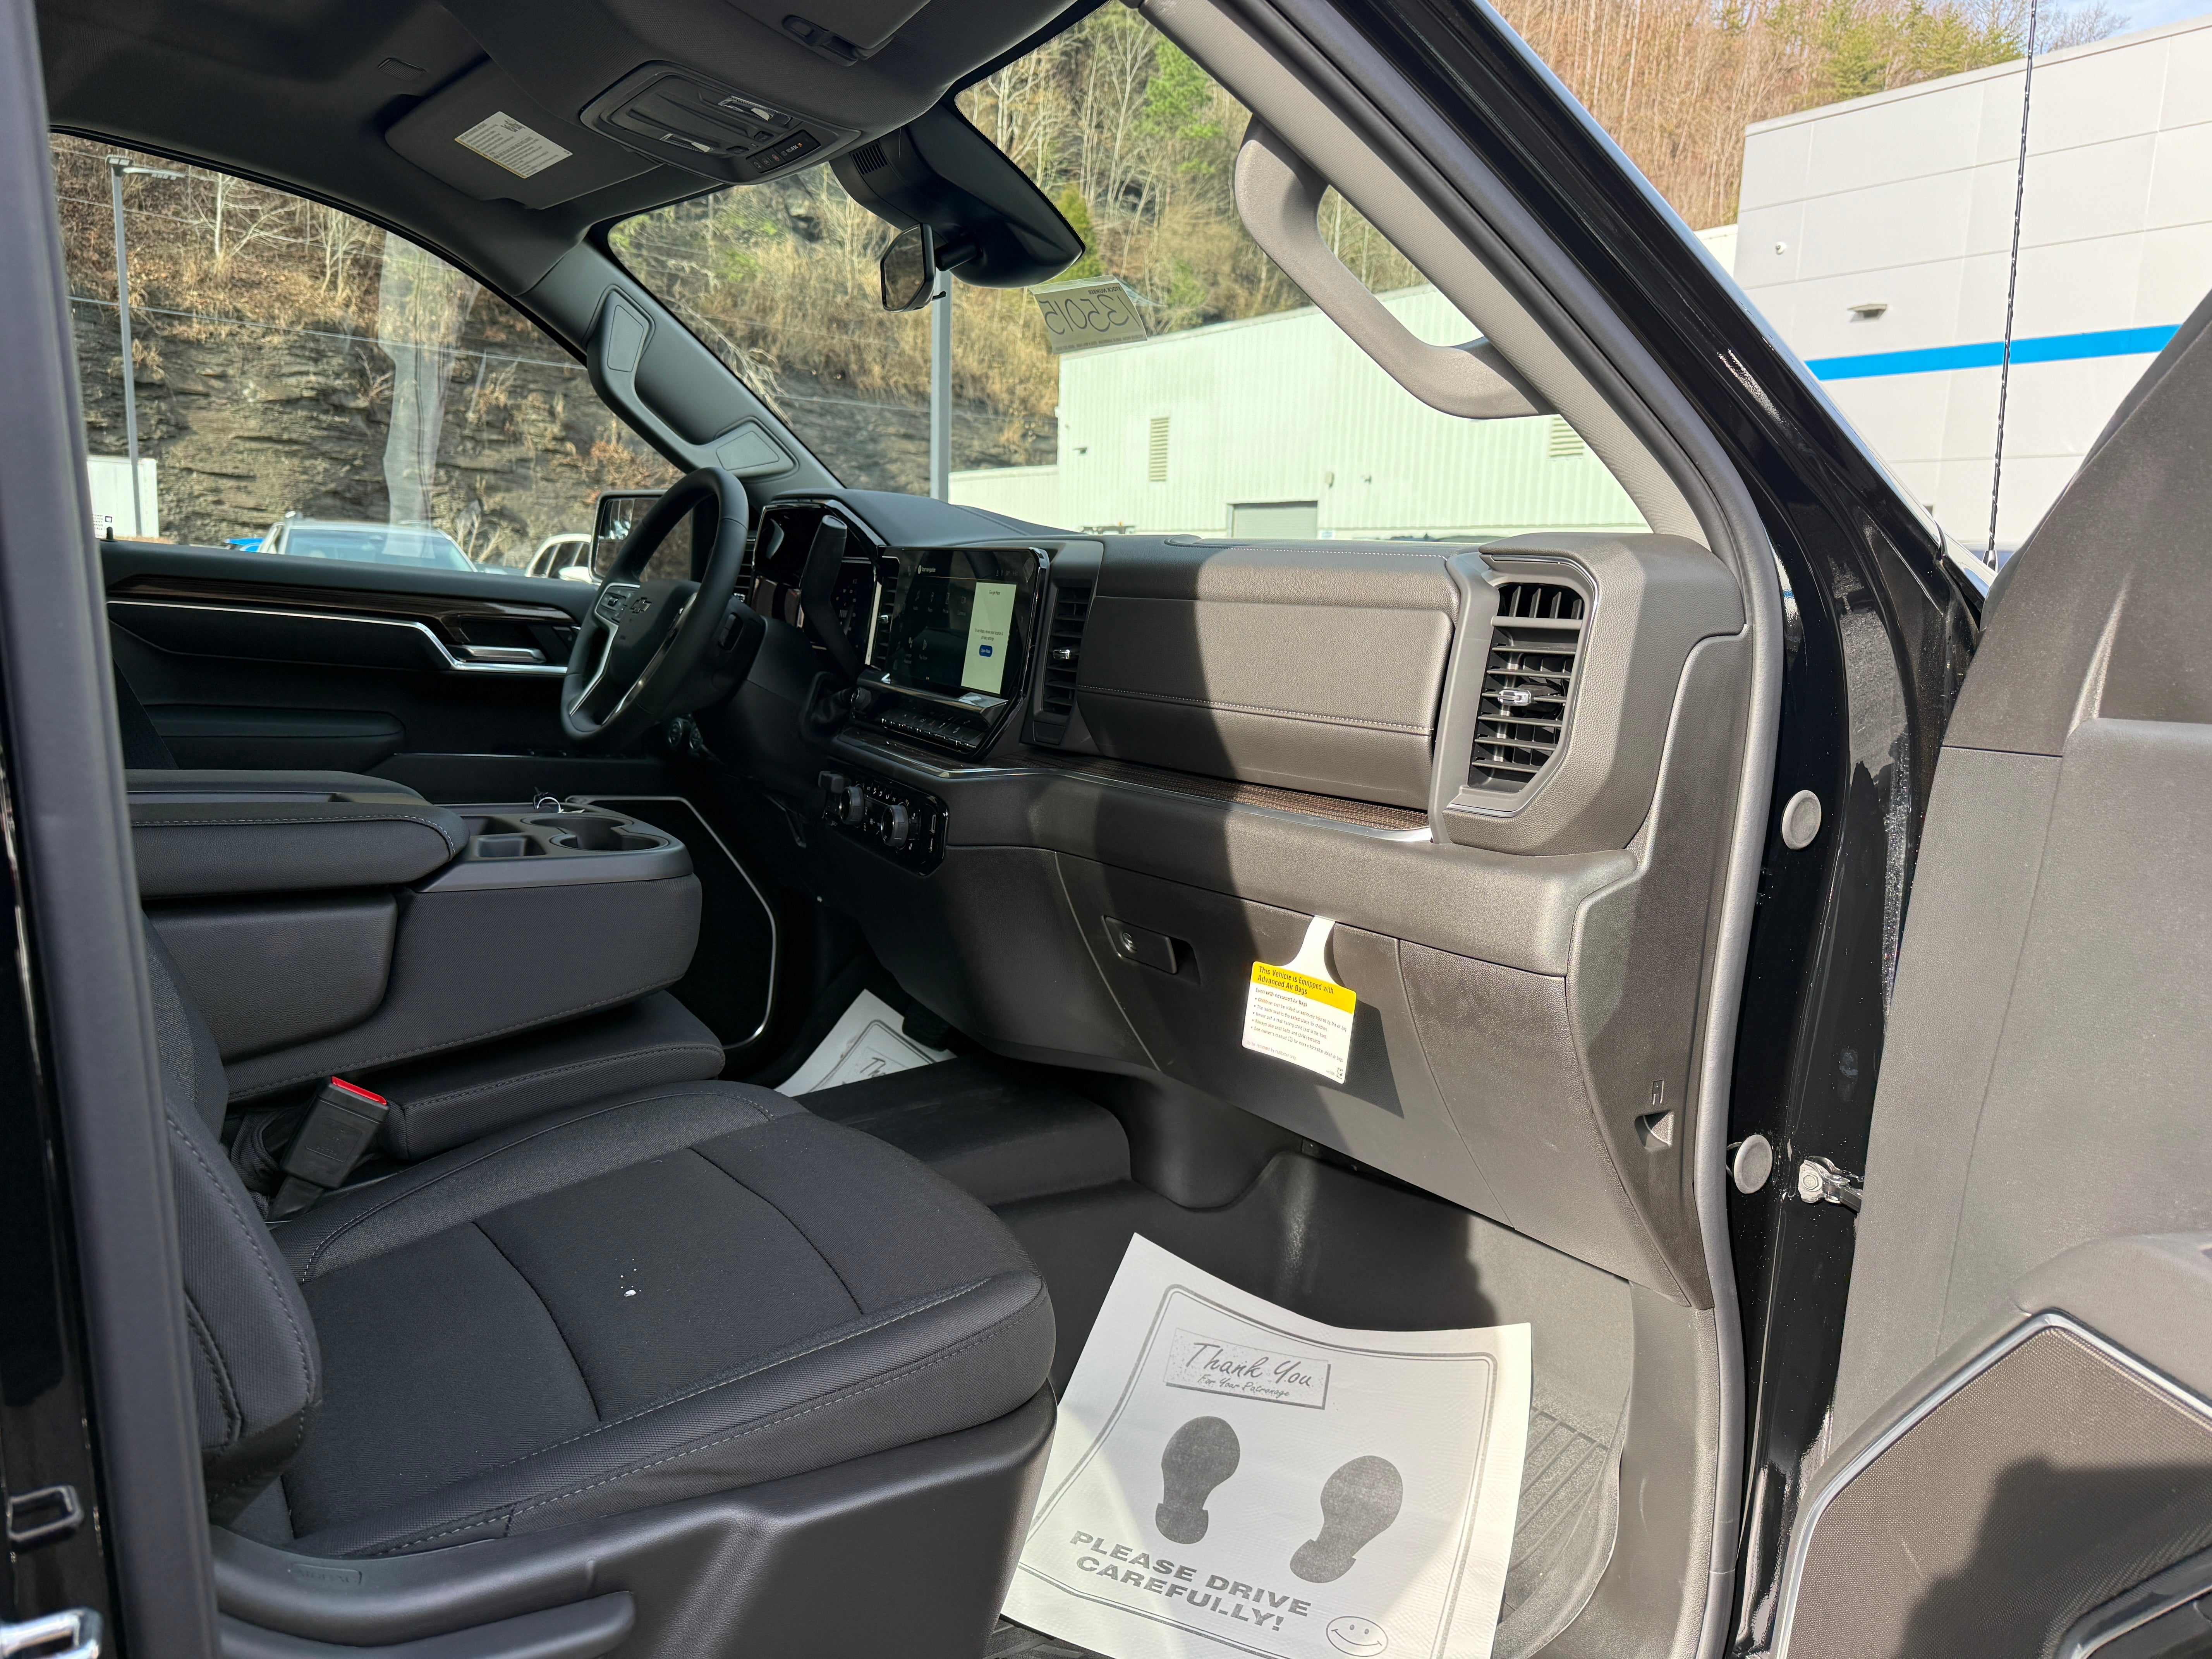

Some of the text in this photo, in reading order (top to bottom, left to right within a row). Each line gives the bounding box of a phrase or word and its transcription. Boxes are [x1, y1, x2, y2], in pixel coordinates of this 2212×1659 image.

[1257, 974, 1285, 987] Advanced
[1295, 984, 1307, 995] Bags
[1259, 966, 1270, 974] This
[1272, 969, 1291, 980] Vehicle
[1298, 977, 1321, 990] Equipped
[1186, 1342, 1310, 1386] Thank You
[1198, 1374, 1290, 1399] For Your Patronage
[1070, 1530, 1312, 1617] PLEASE DRIVE
[1076, 1556, 1284, 1632] CAREFULLY!
